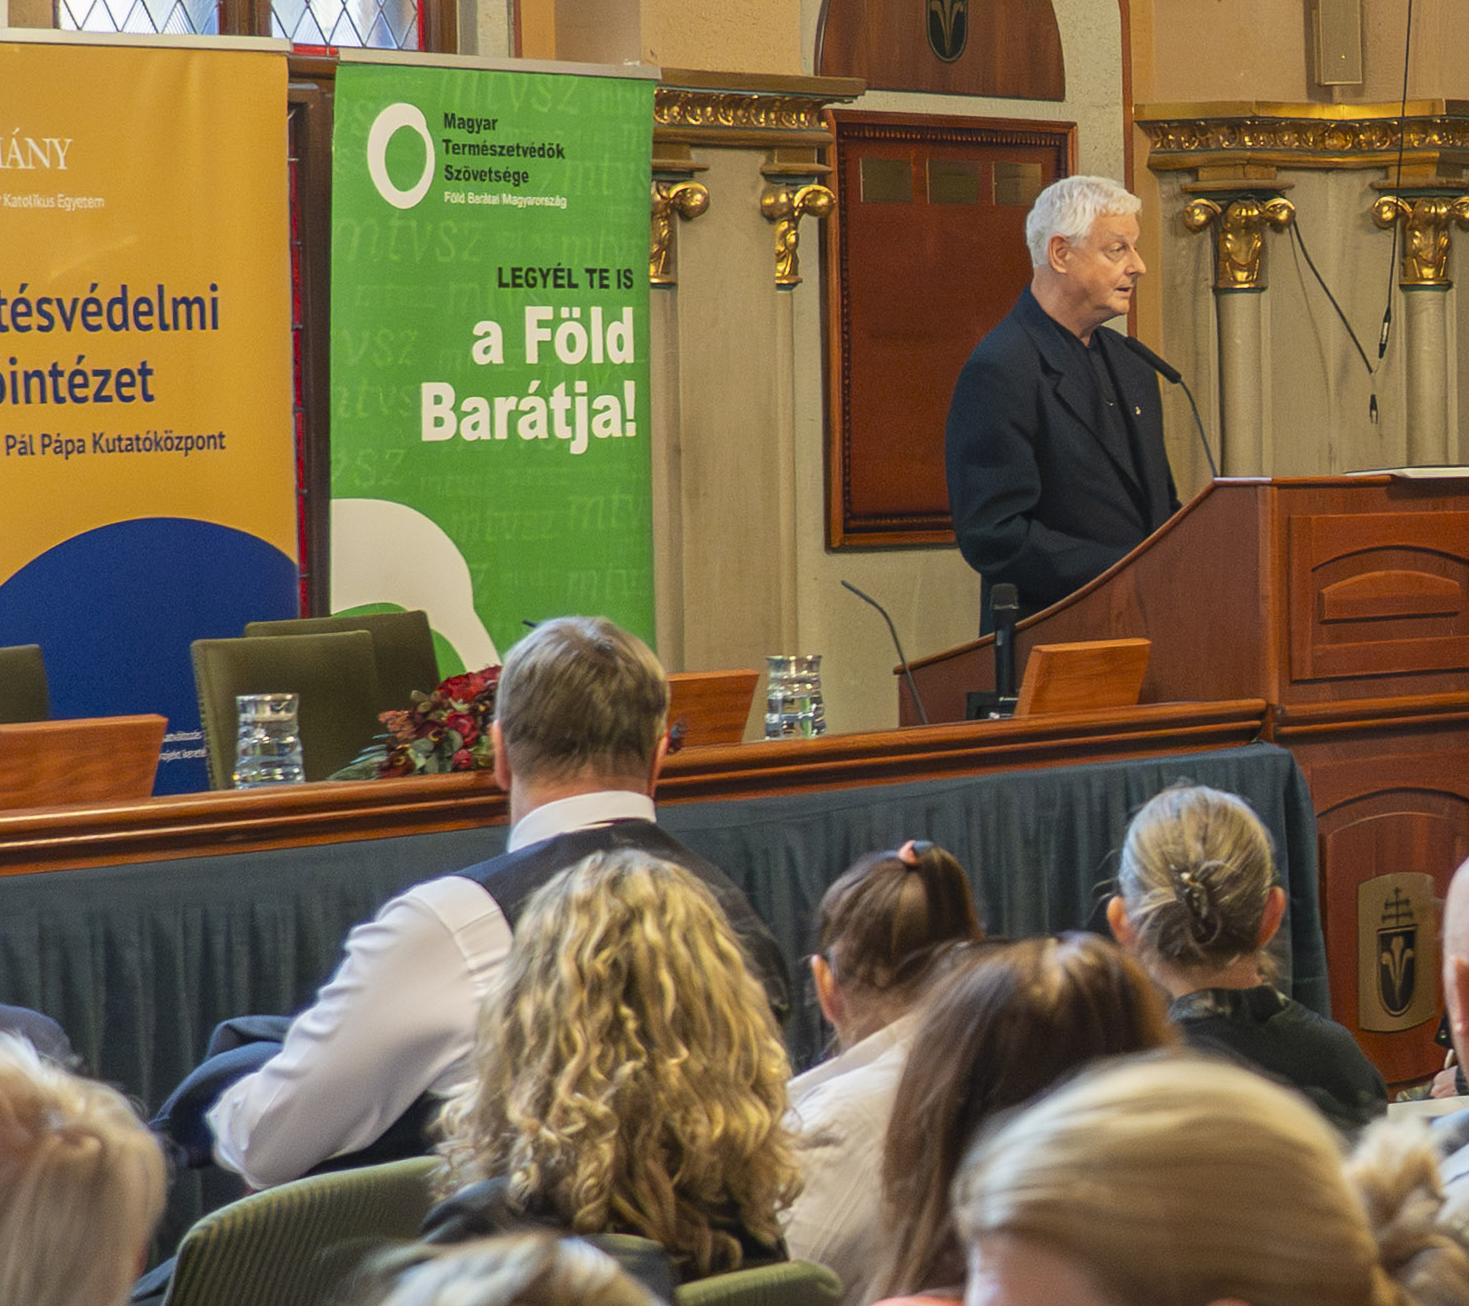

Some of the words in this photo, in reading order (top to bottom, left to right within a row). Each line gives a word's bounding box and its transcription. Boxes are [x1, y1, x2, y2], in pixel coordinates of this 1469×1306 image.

[443, 112, 498, 134] Magyar
[442, 139, 566, 159] Természetvédők
[444, 164, 529, 187] Szövetsége
[3, 193, 55, 209] Katolikus
[57, 194, 105, 212] Egyetem
[444, 191, 465, 204] Föld
[468, 192, 500, 205] Barátai
[502, 193, 567, 209] Magyarország
[498, 263, 579, 289] LEGYÉL
[585, 267, 610, 289] TE
[617, 267, 634, 290] IS
[472, 320, 504, 365] a
[525, 306, 635, 365] Föld
[421, 380, 637, 454] Barátja!
[5, 433, 35, 457] Pál
[40, 432, 86, 460] Pápa
[92, 429, 226, 457] Kutatóközpont
